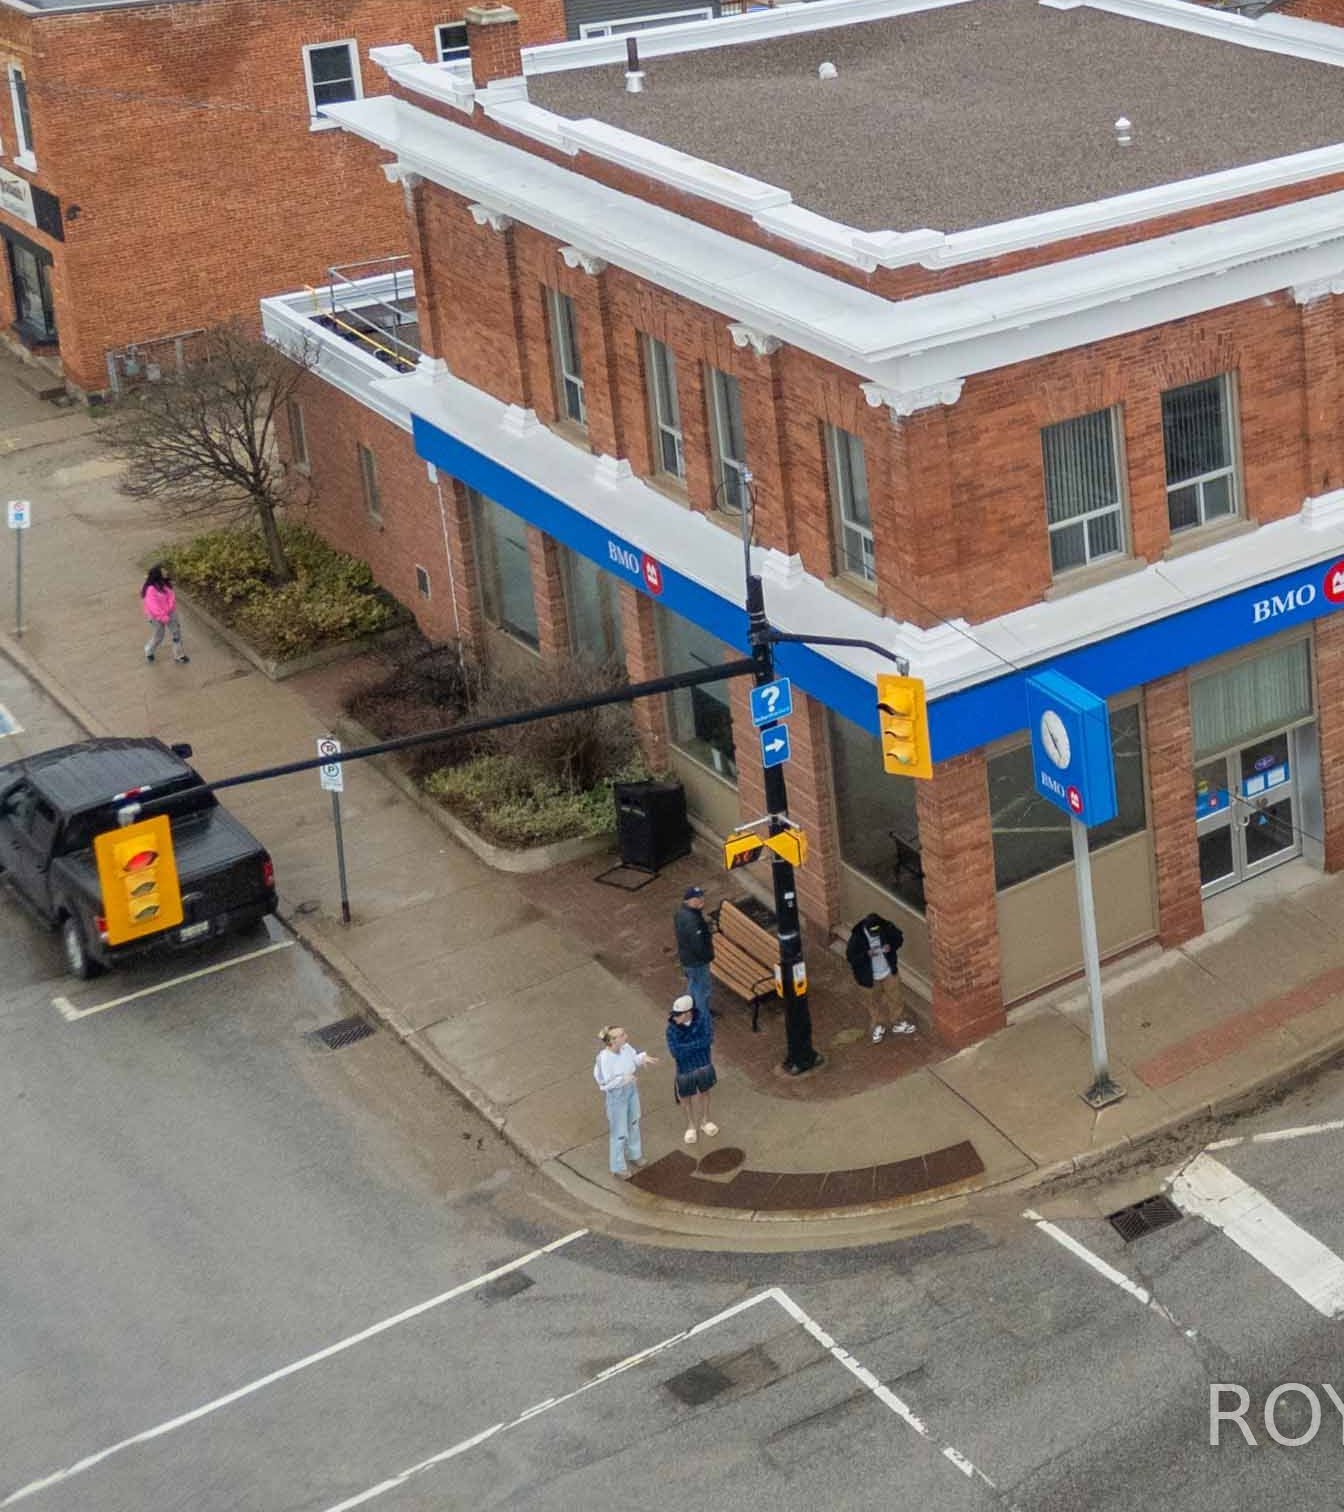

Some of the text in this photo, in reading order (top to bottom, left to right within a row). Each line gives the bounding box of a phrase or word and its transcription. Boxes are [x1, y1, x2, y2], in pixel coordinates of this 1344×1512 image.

[608, 540, 640, 574] BMO
[1252, 584, 1316, 624] BMO
[1041, 771, 1065, 798] BMO
